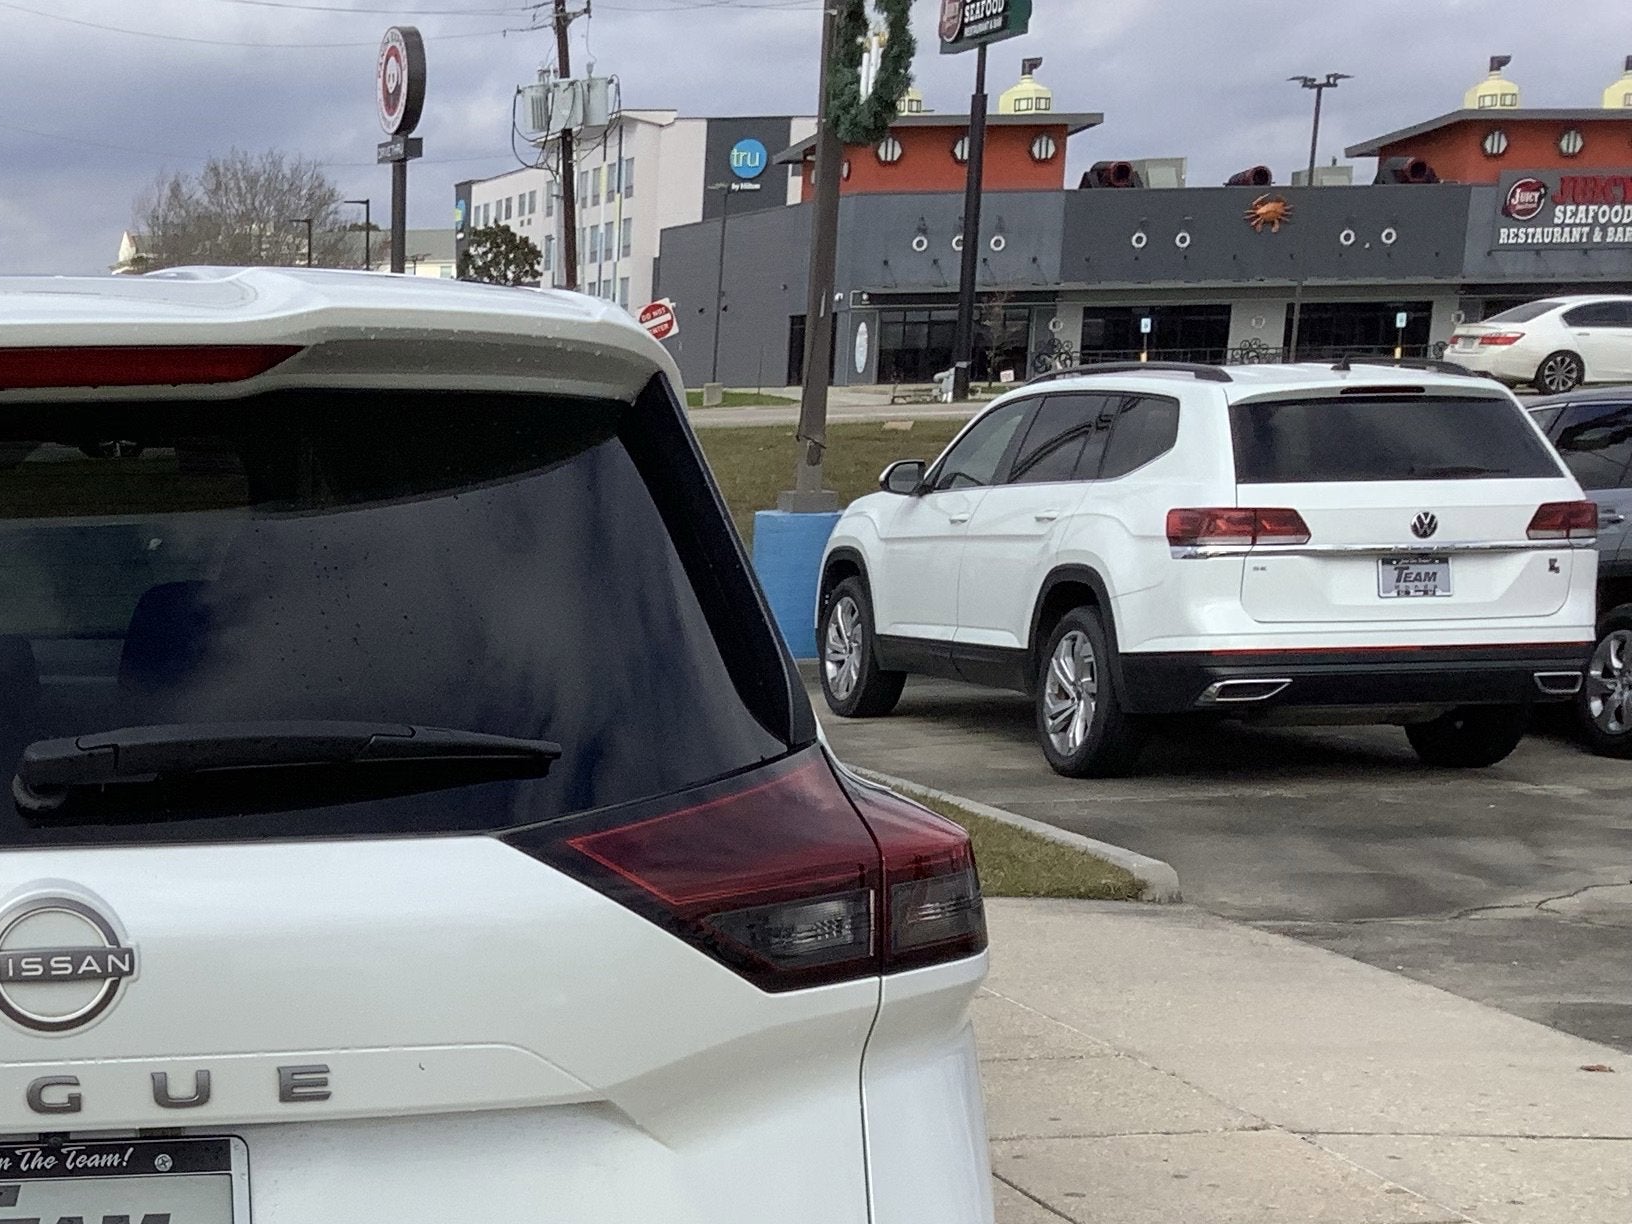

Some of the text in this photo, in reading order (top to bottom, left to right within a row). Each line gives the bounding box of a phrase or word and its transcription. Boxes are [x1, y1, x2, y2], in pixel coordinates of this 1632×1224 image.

[964, 0, 1005, 23] SEAFOOD
[732, 148, 760, 167] tru
[1553, 205, 1632, 224] SEAFOOD
[1499, 226, 1590, 244] RESTAURANT
[1593, 226, 1603, 243] &
[1394, 566, 1438, 583] TEAM
[14, 1147, 58, 1172] The
[60, 1146, 135, 1171] Team!
